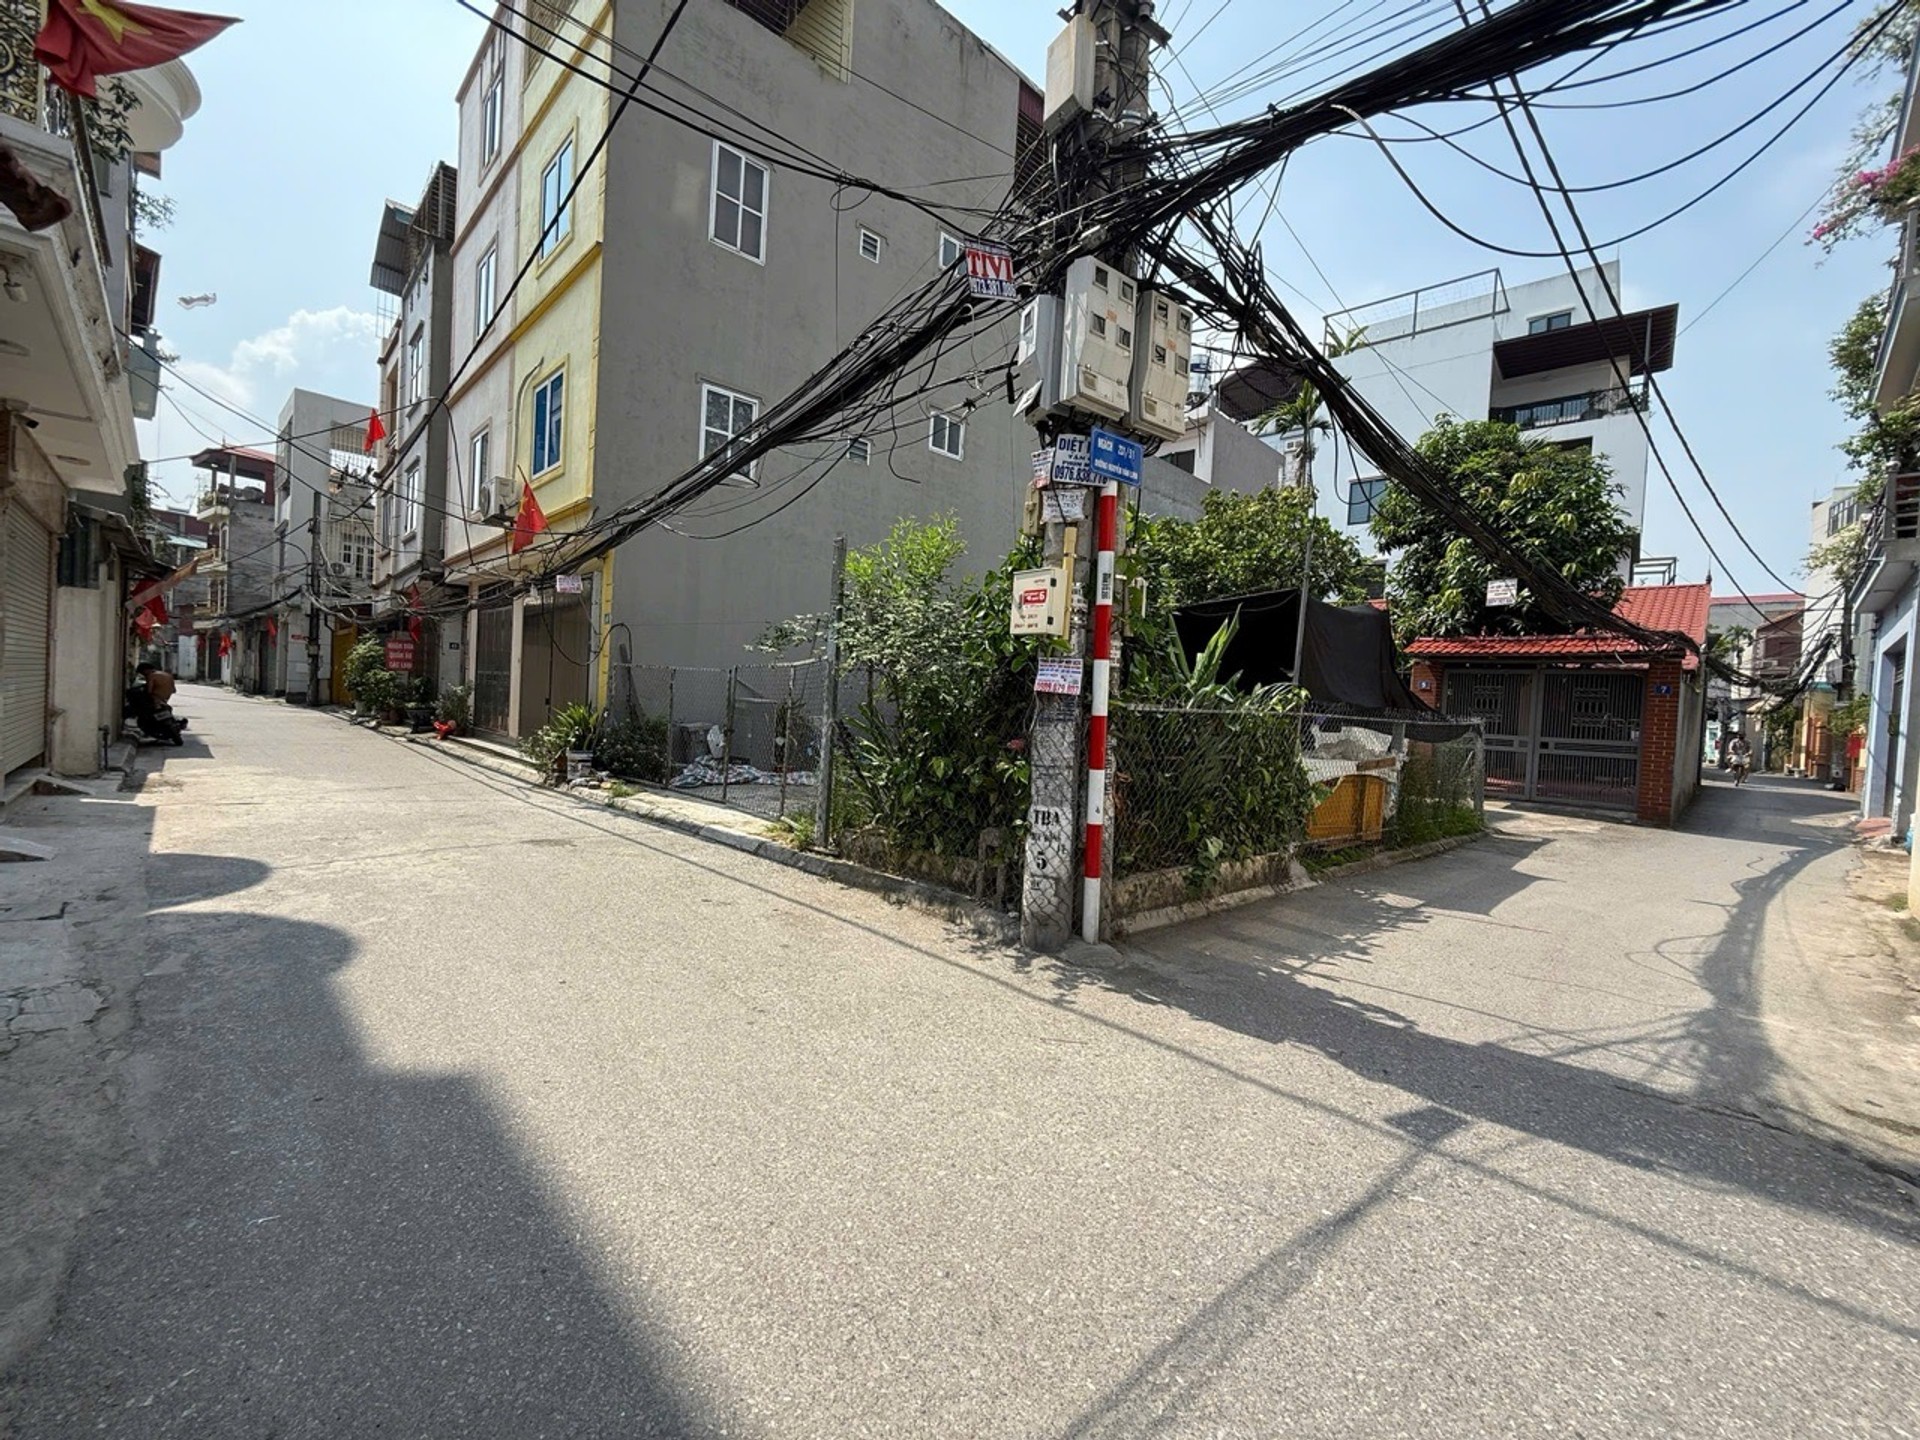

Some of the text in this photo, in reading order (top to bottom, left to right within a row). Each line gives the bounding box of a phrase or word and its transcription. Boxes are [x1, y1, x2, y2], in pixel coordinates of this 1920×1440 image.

[967, 250, 1013, 284] TIVI
[1059, 436, 1084, 453] DIỆT
[1033, 809, 1060, 826] TBA
[1036, 850, 1047, 870] 5
